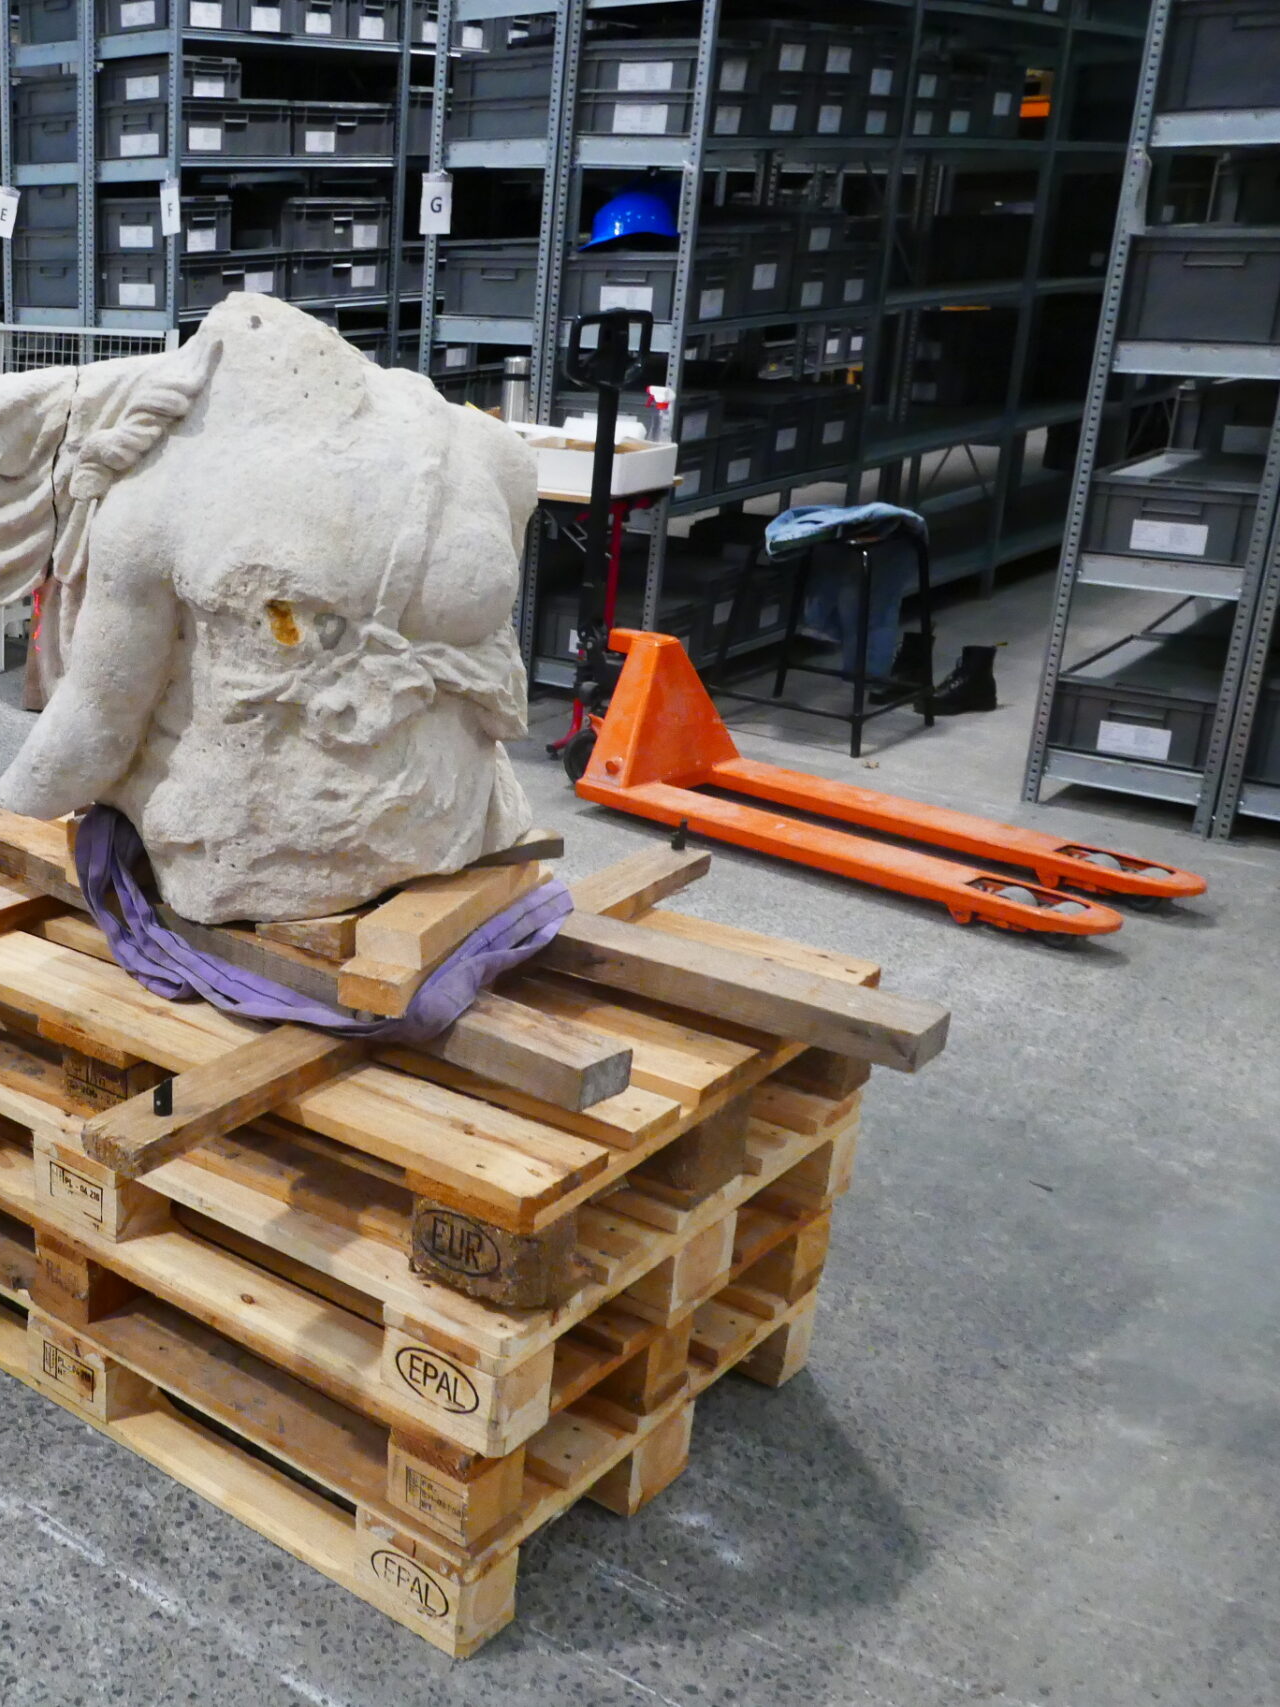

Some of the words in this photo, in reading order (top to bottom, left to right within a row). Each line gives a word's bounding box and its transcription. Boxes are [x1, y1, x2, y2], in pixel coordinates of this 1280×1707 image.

[167, 202, 173, 217] F
[431, 196, 442, 213] G
[0, 208, 8, 222] E
[432, 1216, 483, 1270] EUR
[408, 1353, 466, 1410] EPAL
